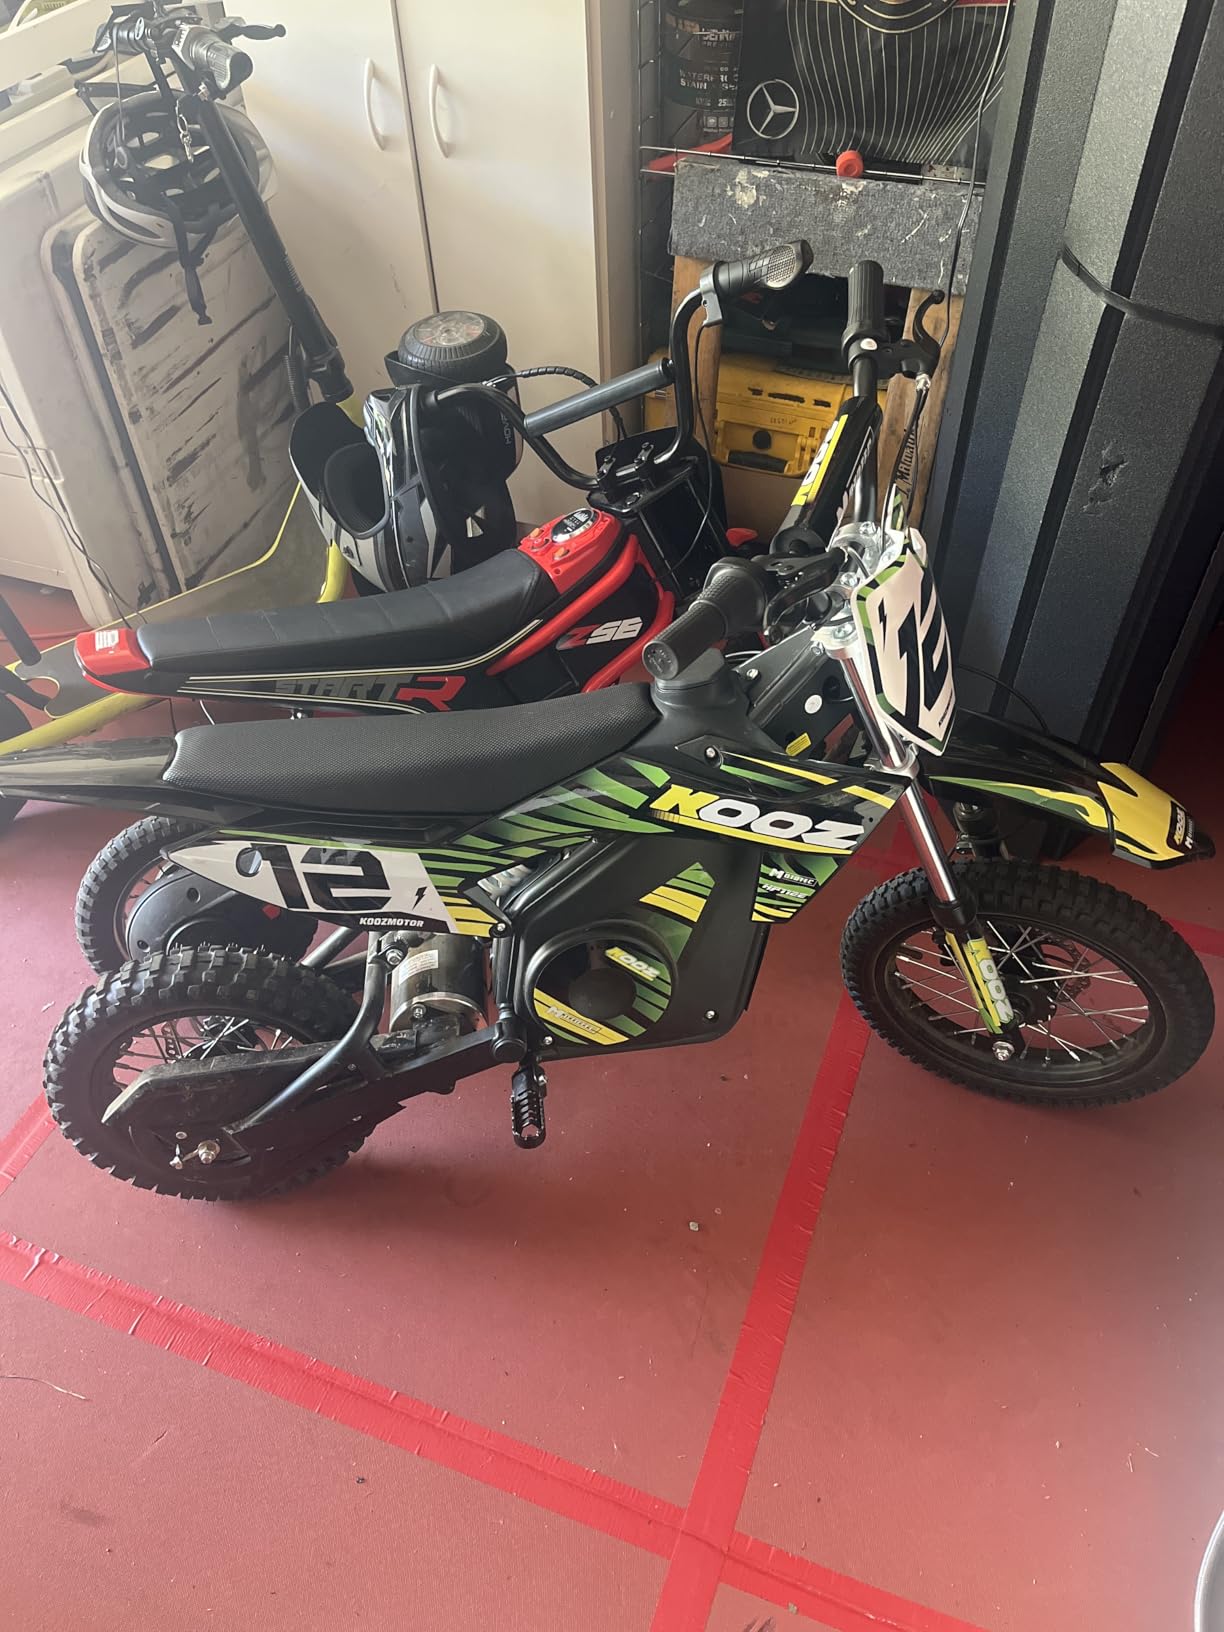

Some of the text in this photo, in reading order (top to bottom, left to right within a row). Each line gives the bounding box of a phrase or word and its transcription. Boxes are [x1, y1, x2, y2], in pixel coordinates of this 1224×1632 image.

[649, 784, 865, 850] KOOZ
[250, 842, 392, 911] 12
[359, 916, 425, 929] KOOZMOTOR
[605, 946, 661, 978] KOOZ
[968, 937, 1014, 1023] KOOZ
